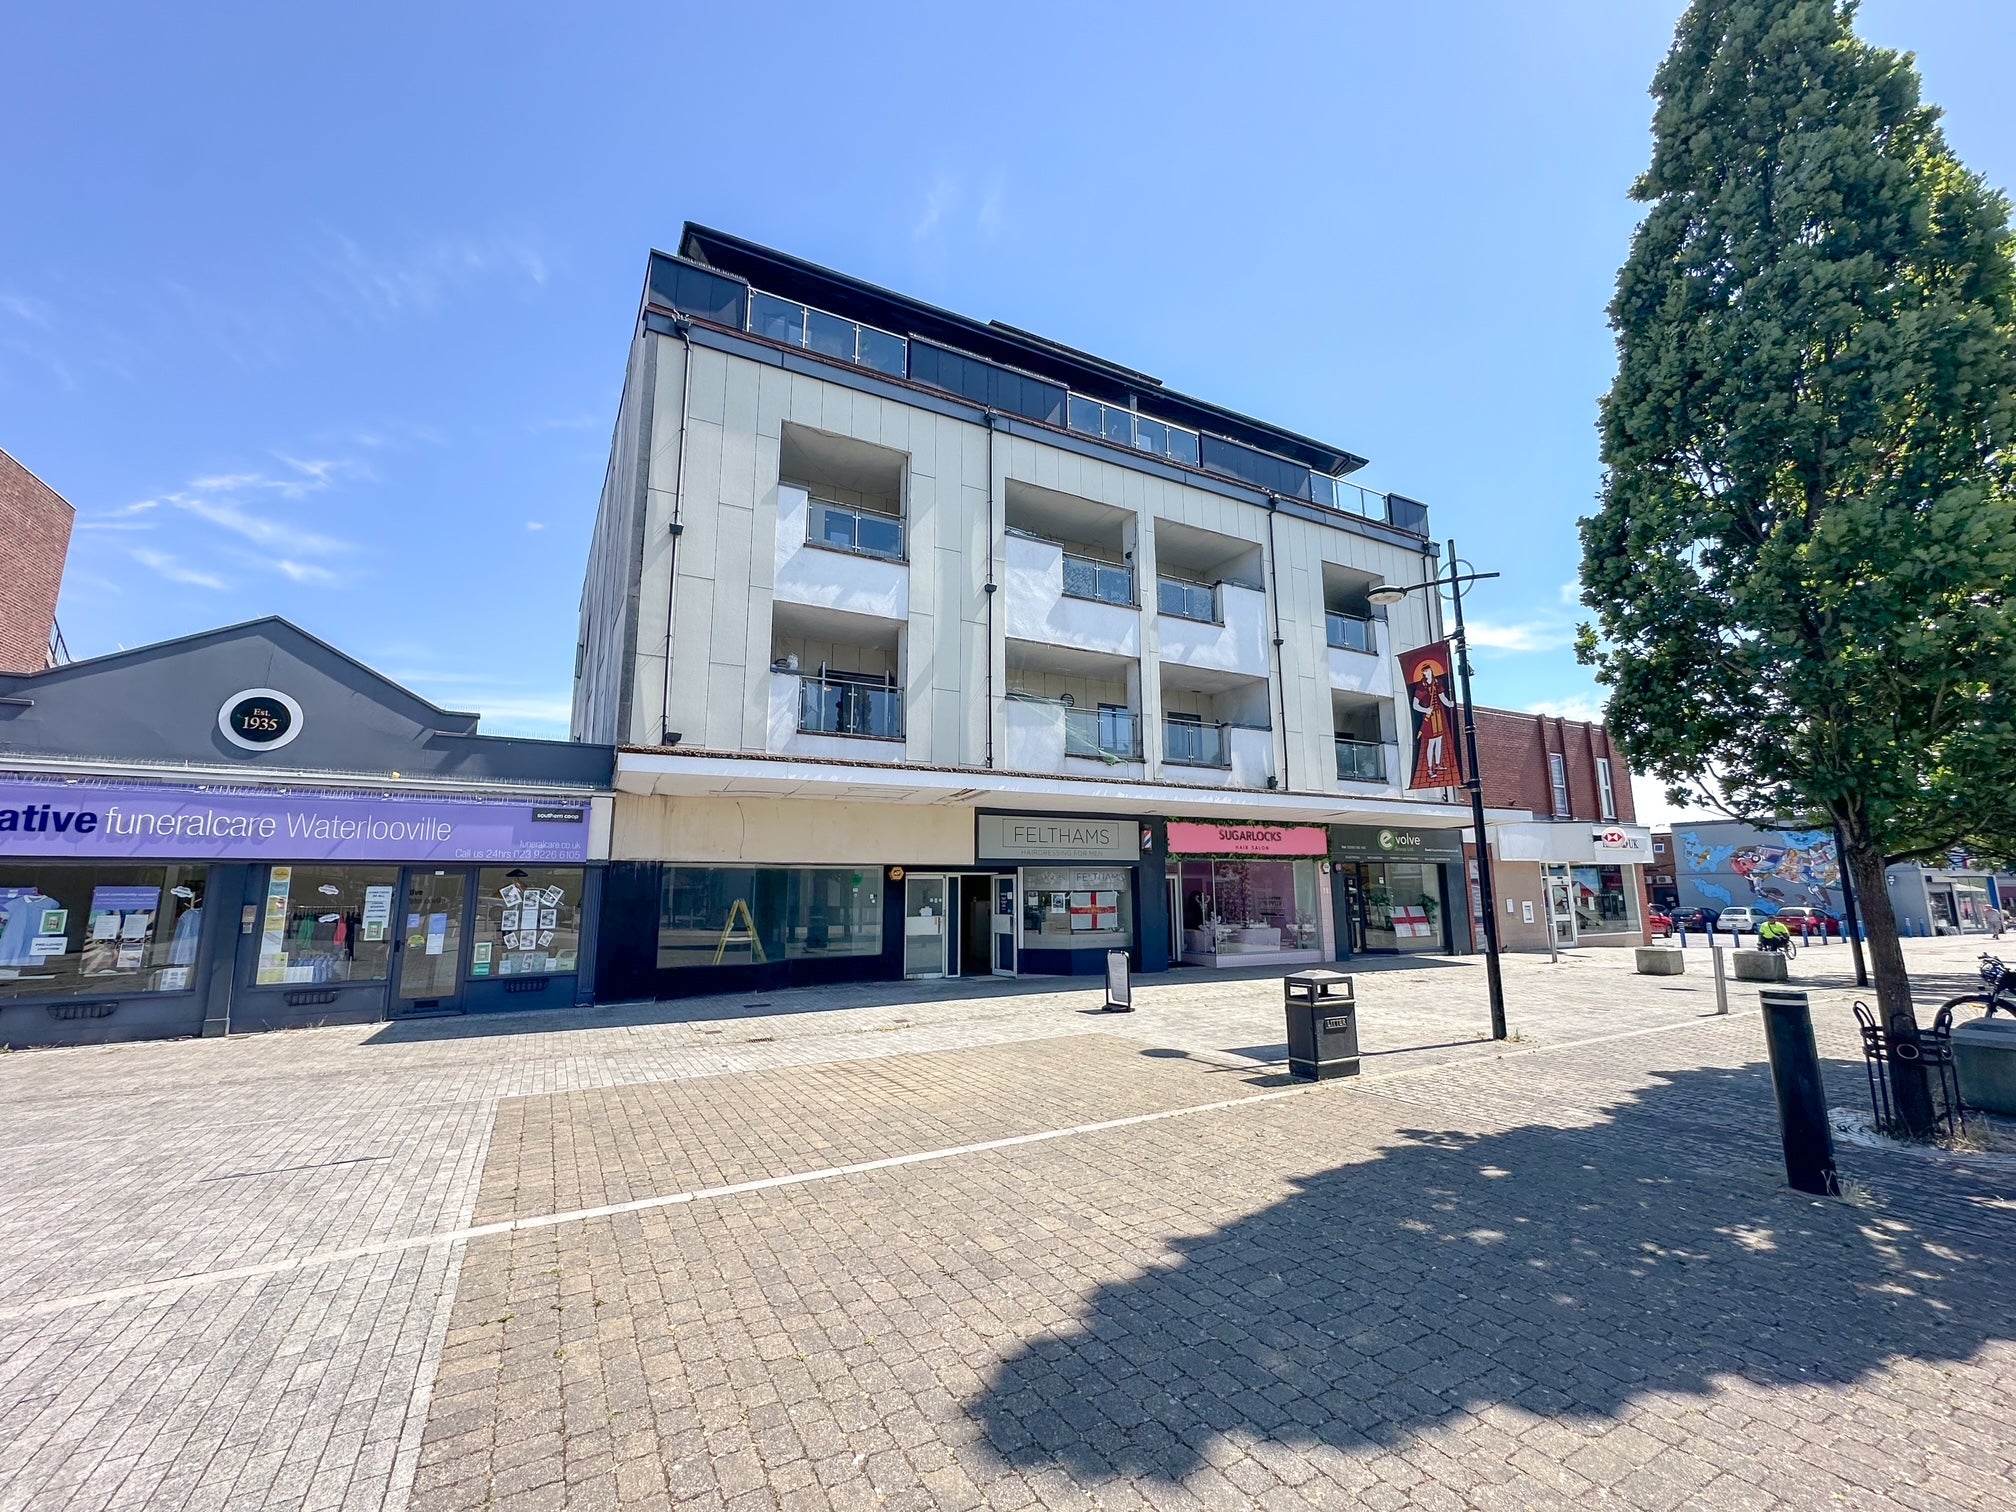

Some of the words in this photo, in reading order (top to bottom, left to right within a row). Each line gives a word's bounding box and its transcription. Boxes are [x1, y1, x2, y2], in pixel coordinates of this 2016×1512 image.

[253, 708, 271, 717] Est.
[242, 716, 279, 731] 1935
[0, 804, 98, 834] ative
[105, 806, 276, 838] funeralcare
[286, 812, 451, 841] Waterlooville
[1014, 826, 1111, 845] FELTHAMS
[1219, 829, 1282, 842] SUGARLOCKS
[1628, 839, 1639, 849] UK
[455, 848, 471, 859] Call
[473, 849, 484, 859] us
[486, 849, 511, 860] 24hrs
[513, 850, 531, 860] 023
[1020, 848, 1072, 857] HAIRDRESSING
[1326, 1018, 1347, 1028] LITTER
